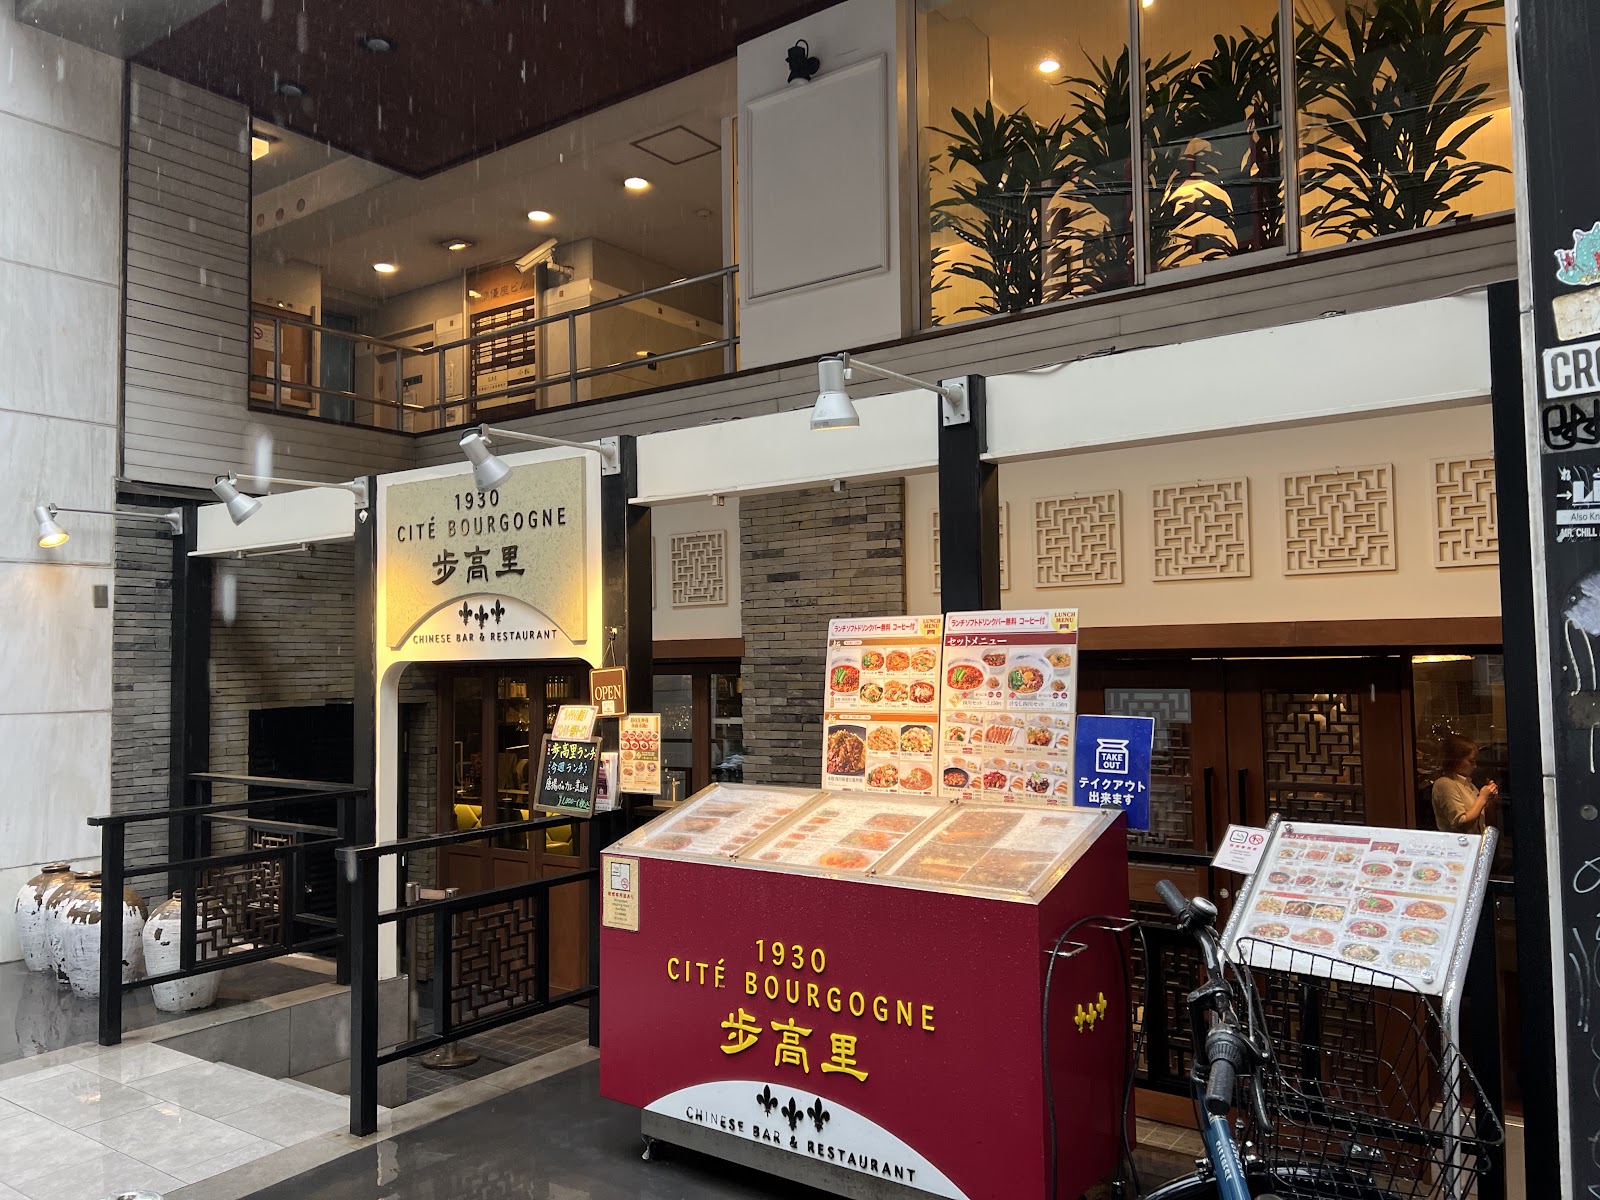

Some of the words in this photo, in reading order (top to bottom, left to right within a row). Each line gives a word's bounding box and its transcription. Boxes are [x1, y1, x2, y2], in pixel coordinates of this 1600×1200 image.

[1551, 346, 1600, 392] CR
[454, 489, 499, 510] 1930
[397, 516, 436, 542] CITÉ
[448, 507, 566, 537] BOURGOGNE
[1571, 513, 1587, 521] Also
[1576, 527, 1597, 537] CHILL
[413, 634, 451, 645] CHINESE
[456, 634, 474, 642] BAR
[479, 633, 485, 642] &
[490, 629, 557, 642] RESTAURANT
[947, 636, 1007, 647] セットメニュー
[594, 685, 621, 701] OPEN
[1101, 753, 1123, 761] TAKE
[1103, 761, 1121, 769] OUT
[1079, 777, 1145, 793] テイクアウト
[1089, 791, 1134, 805] 出来ます
[756, 939, 826, 974] 1930
[667, 957, 726, 988] CITÉ
[745, 972, 936, 1031] BOURGOGNE
[686, 1106, 745, 1132] CHINESE
[752, 1125, 780, 1144] BAR
[789, 1135, 798, 1149] &
[807, 1140, 917, 1182] RESTAURANT
